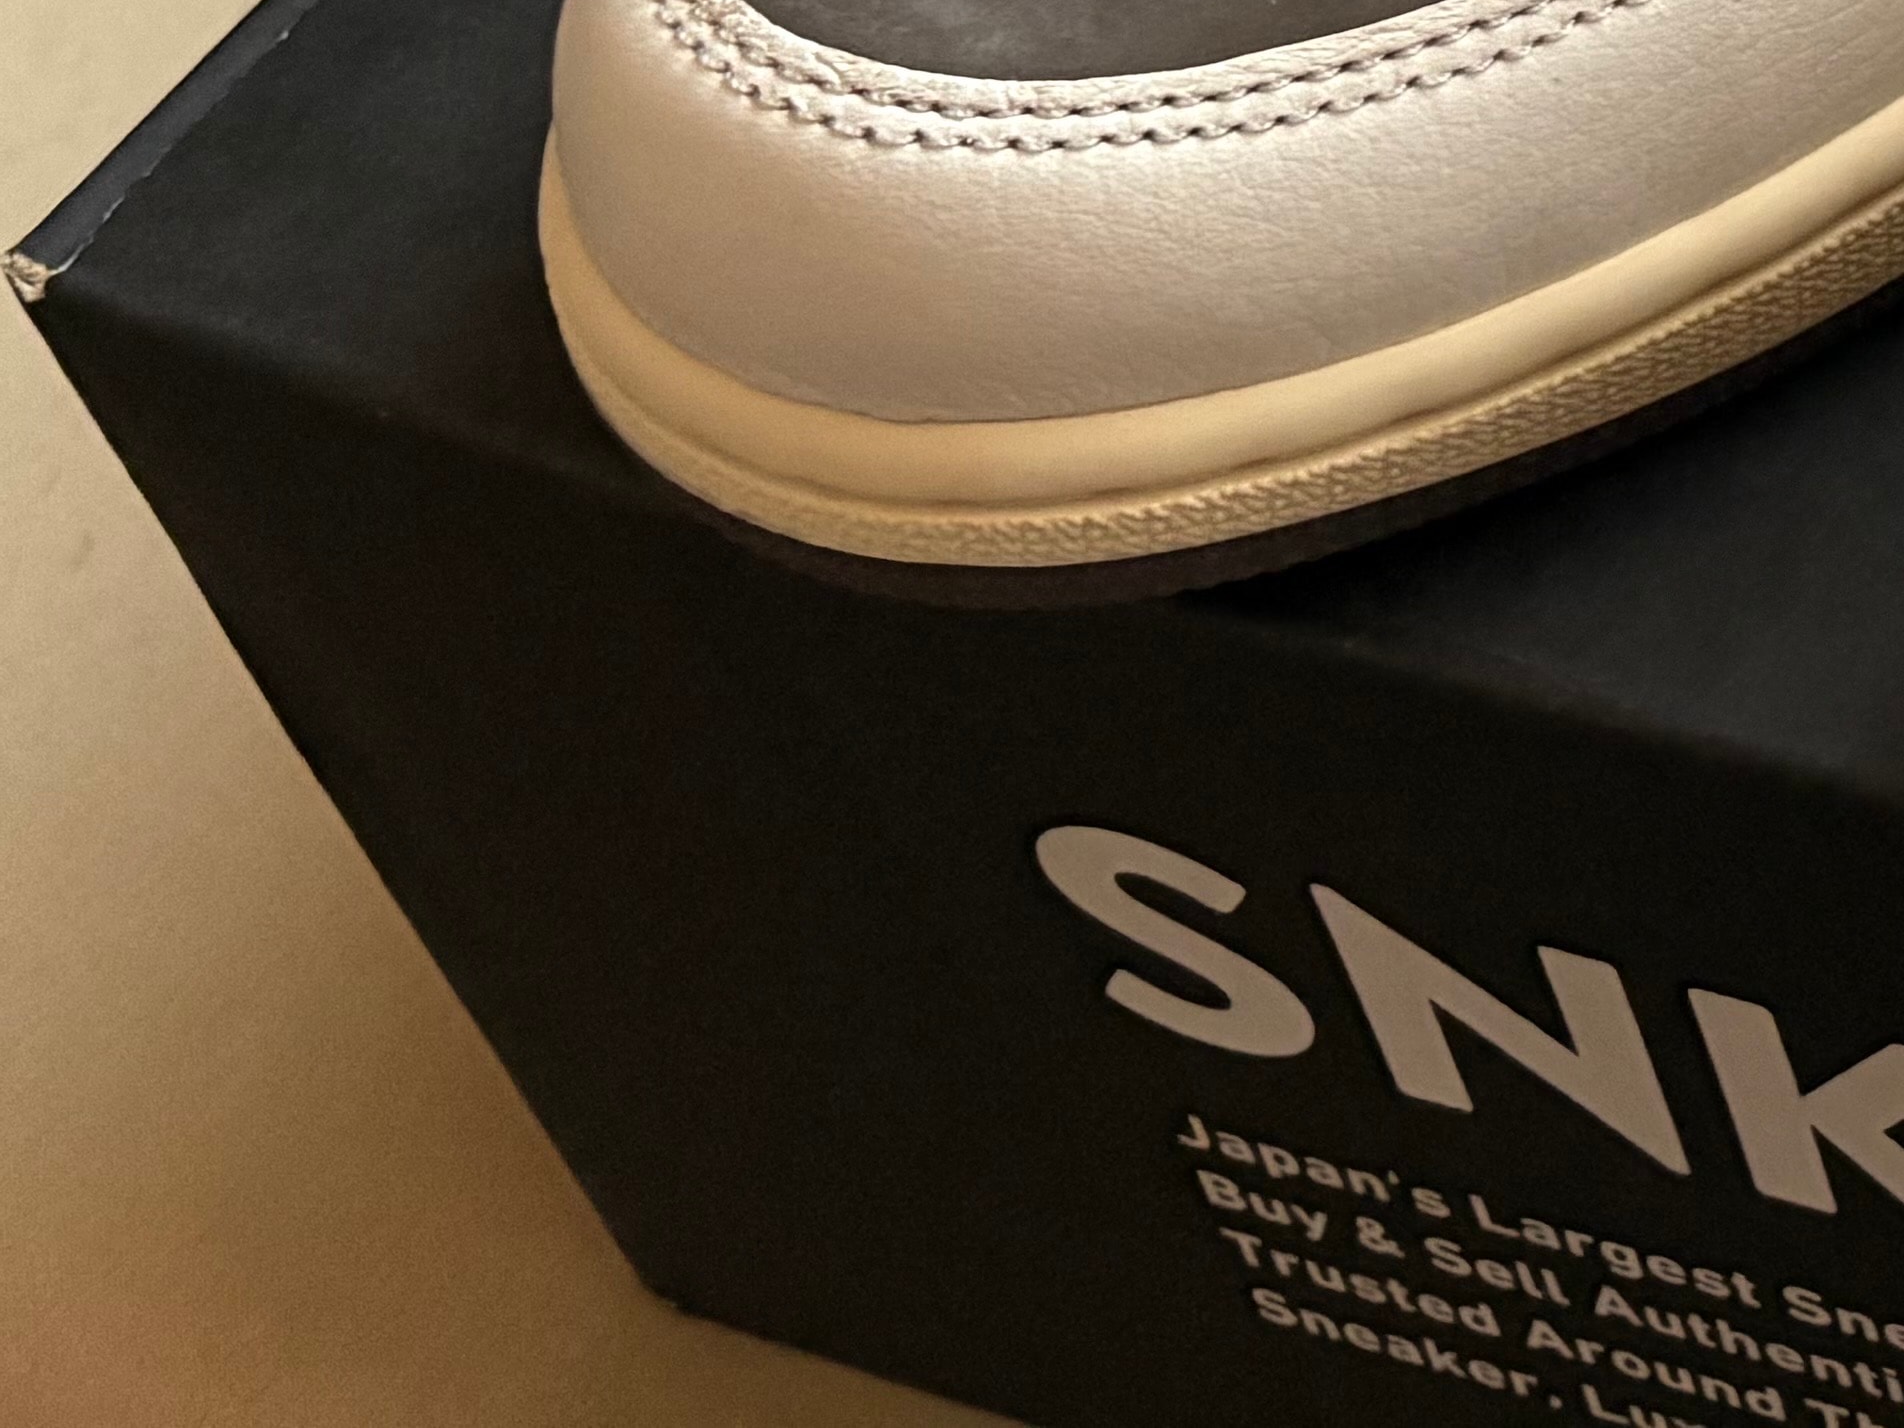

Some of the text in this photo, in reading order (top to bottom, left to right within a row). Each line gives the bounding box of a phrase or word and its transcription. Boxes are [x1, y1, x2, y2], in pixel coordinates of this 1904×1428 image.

[1178, 1114, 1452, 1219] Japan's
[1469, 1193, 1761, 1309] Largest
[1196, 1169, 1328, 1242] Buy
[1356, 1216, 1407, 1259] &
[1424, 1237, 1571, 1307] Sell
[1218, 1227, 1502, 1338] Trusted
[1526, 1318, 1787, 1422] Around
